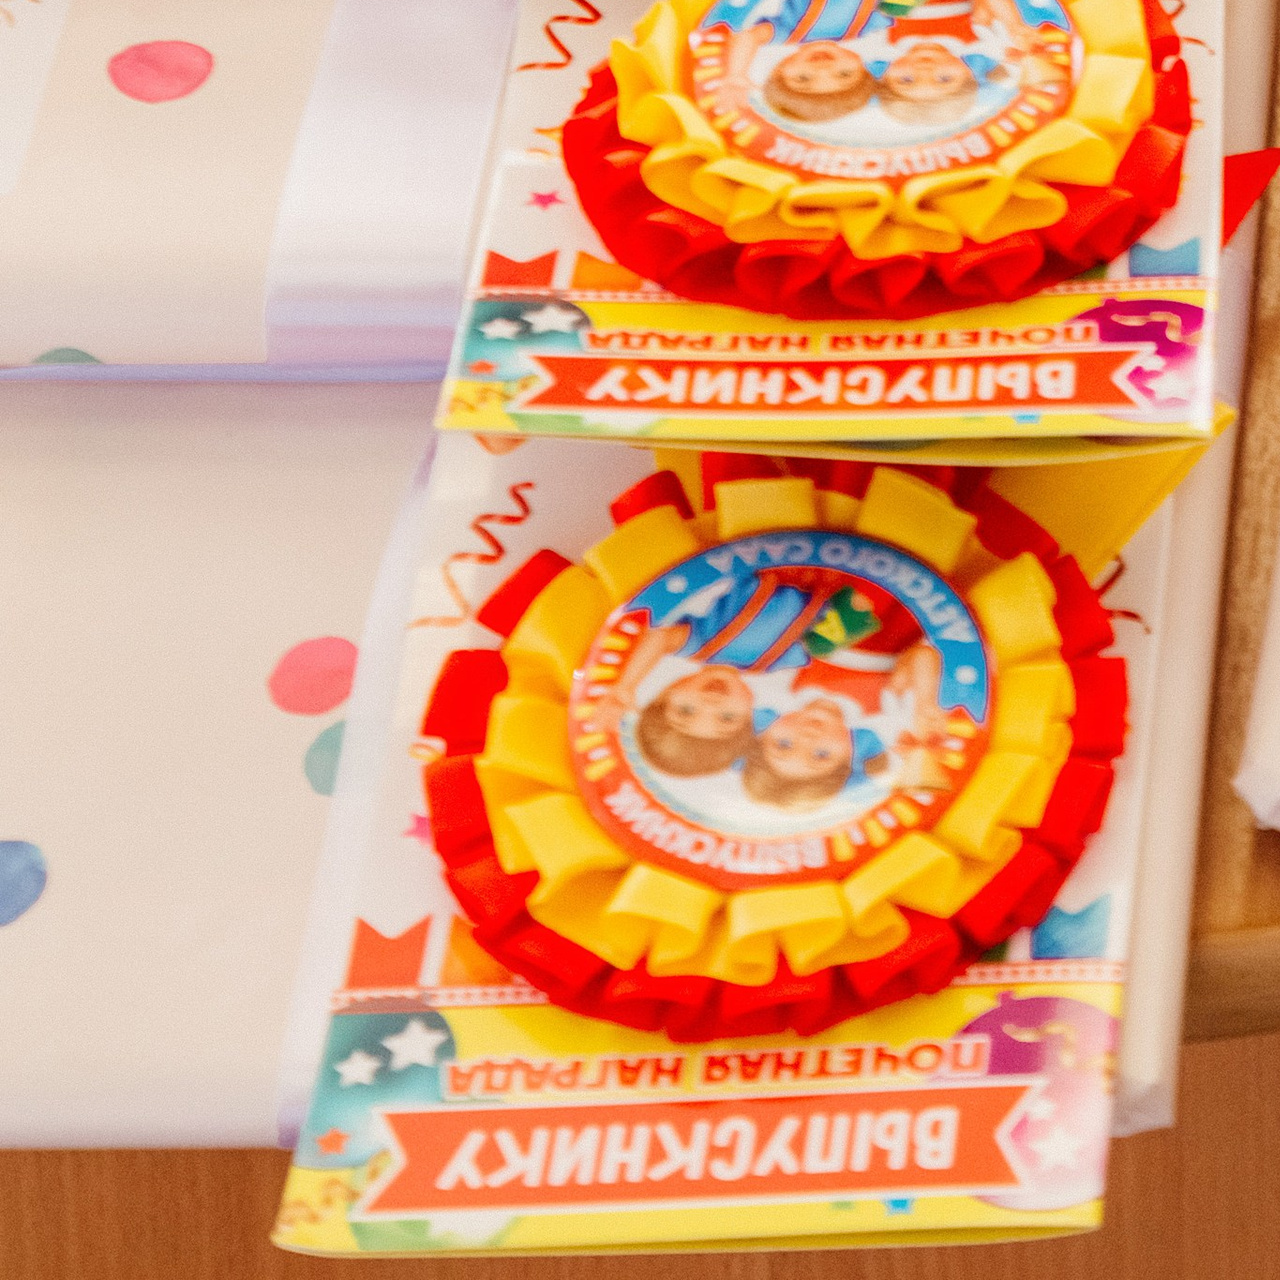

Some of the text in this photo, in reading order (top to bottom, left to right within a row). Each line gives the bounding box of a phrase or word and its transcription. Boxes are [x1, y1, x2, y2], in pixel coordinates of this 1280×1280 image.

[764, 134, 992, 178] ВЫПУСКНИК
[586, 326, 1095, 352] ПОЧЕТНАЯ НАГРАДА
[585, 361, 1077, 405] ВЫПУСКНИКУ
[603, 783, 830, 876] ВЫПУСКНИК
[447, 1040, 983, 1094] ПОЧЕТНАЯ НАГРАДА
[435, 1106, 960, 1191] ВЫПУСКНИКУ
